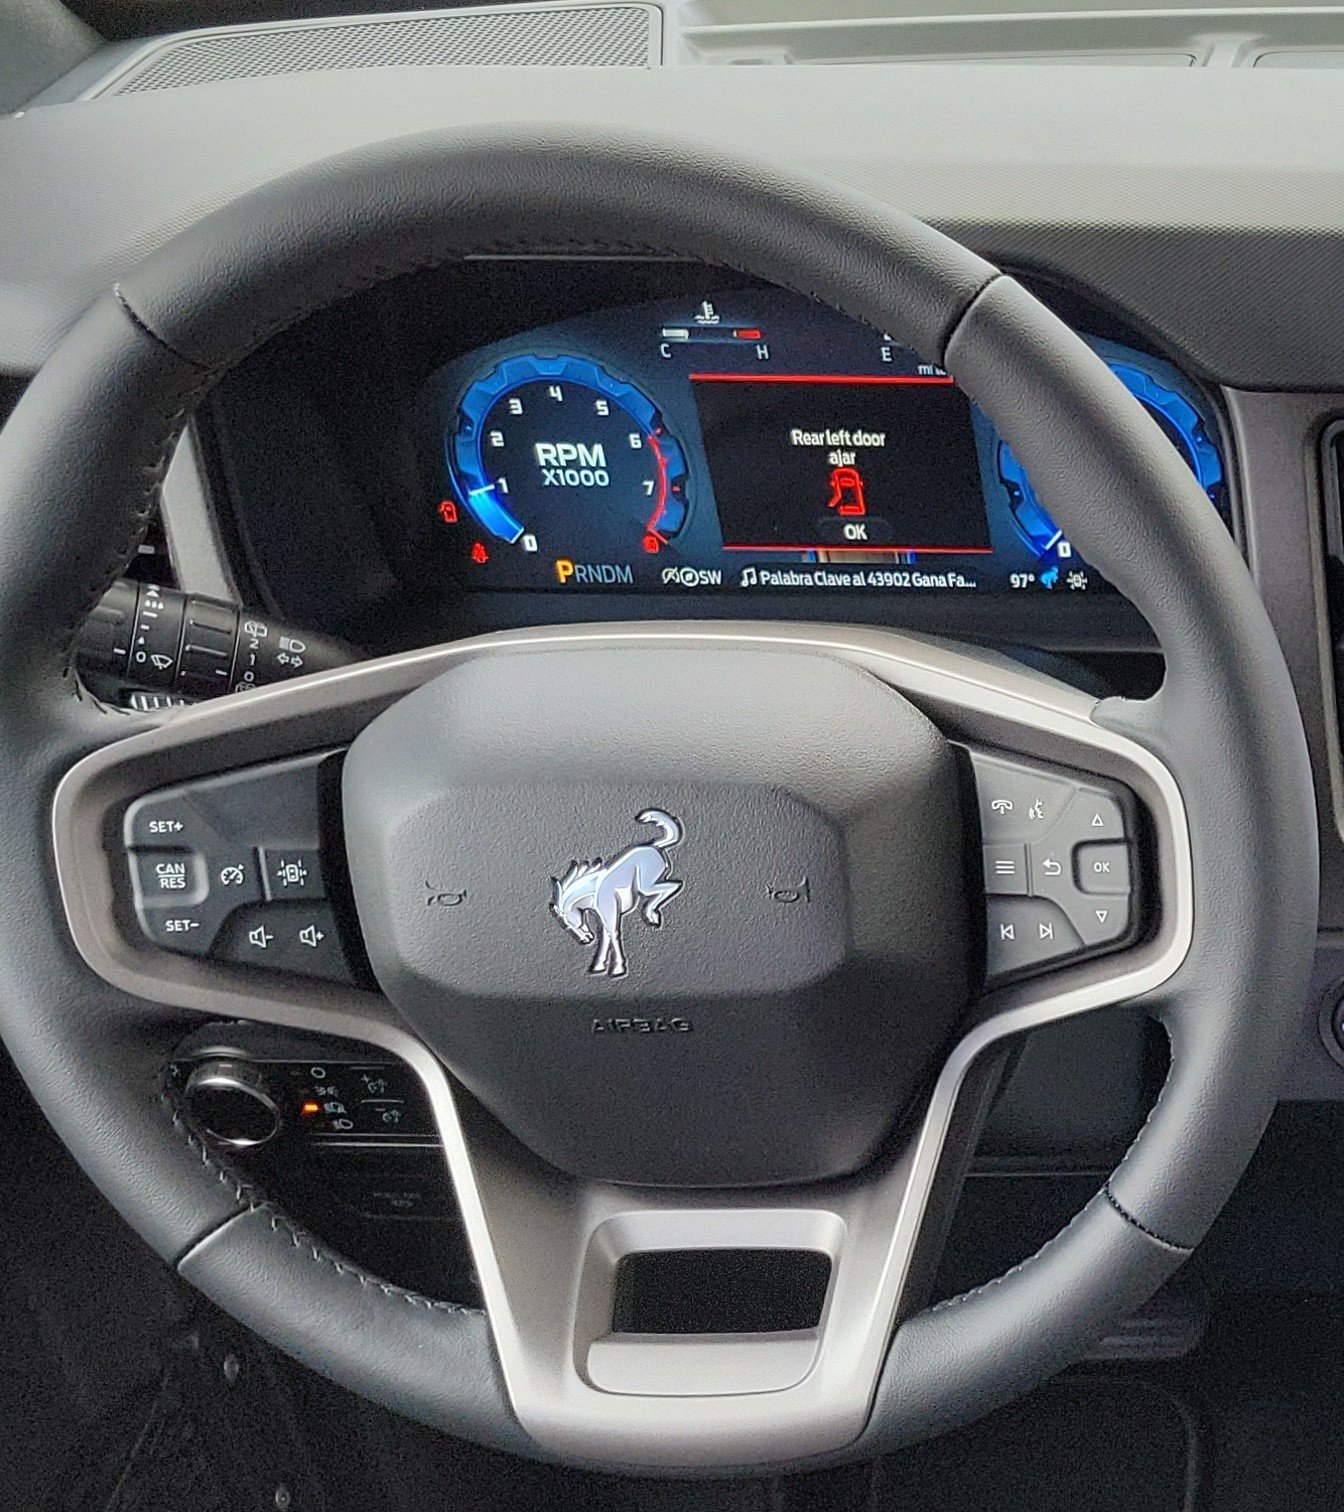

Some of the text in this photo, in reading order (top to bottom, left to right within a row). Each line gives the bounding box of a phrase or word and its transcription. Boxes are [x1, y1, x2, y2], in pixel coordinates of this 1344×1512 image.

[660, 344, 672, 359] C
[756, 344, 770, 360] H
[881, 346, 893, 362] E
[549, 385, 563, 402] 4
[508, 398, 523, 414] 3
[595, 400, 610, 416] 5
[489, 430, 505, 447] 2
[628, 433, 642, 449] 6
[791, 429, 886, 447] Rear left door
[535, 443, 607, 467] RPM
[828, 449, 857, 467] ajar
[497, 477, 508, 494] 1
[541, 469, 610, 487] X1000
[642, 480, 655, 495] 7
[843, 523, 868, 540] OK
[699, 571, 722, 586] SW
[760, 570, 811, 588] Palabra
[814, 571, 851, 588] Clave
[852, 571, 867, 588] al
[867, 571, 910, 588] 43902
[912, 571, 946, 588] Gana
[1009, 572, 1036, 589] 97°
[149, 820, 184, 833] SET+
[155, 863, 185, 874] CAN
[1093, 862, 1110, 873] OK
[160, 878, 187, 889] RES
[589, 1017, 694, 1034] AIRBAG
